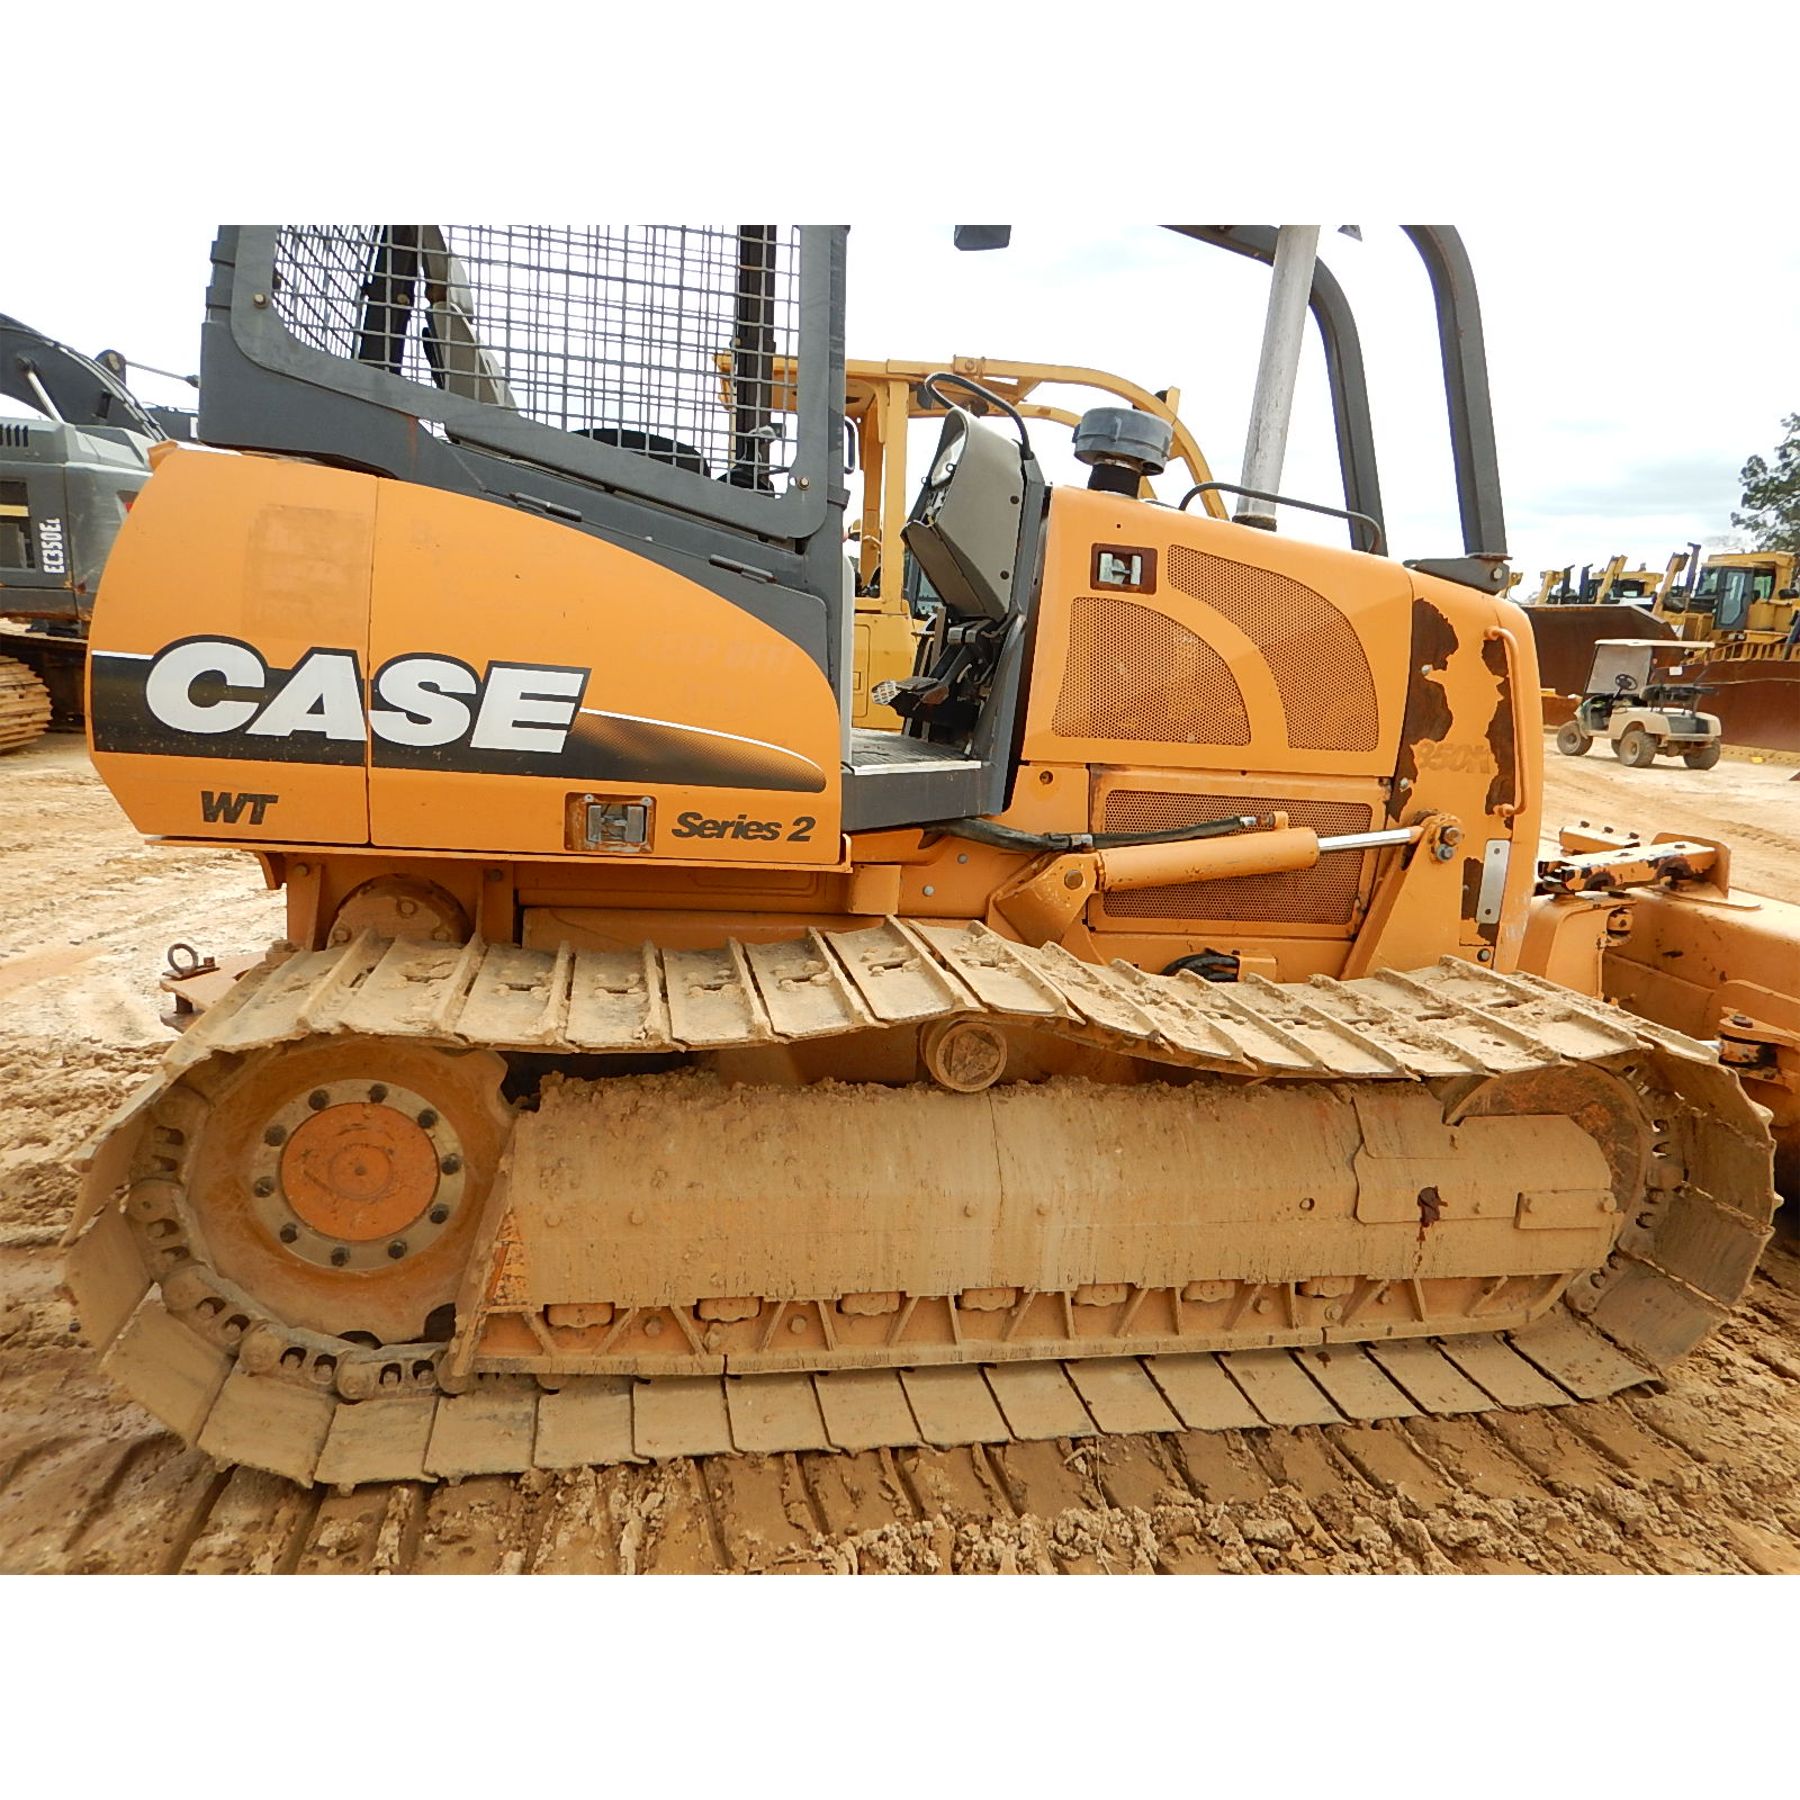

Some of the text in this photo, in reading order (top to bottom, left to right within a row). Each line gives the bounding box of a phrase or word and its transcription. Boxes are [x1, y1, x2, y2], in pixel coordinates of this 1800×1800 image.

[146, 641, 585, 754] CASE
[201, 791, 279, 826] WT
[672, 812, 816, 842] Series 2
